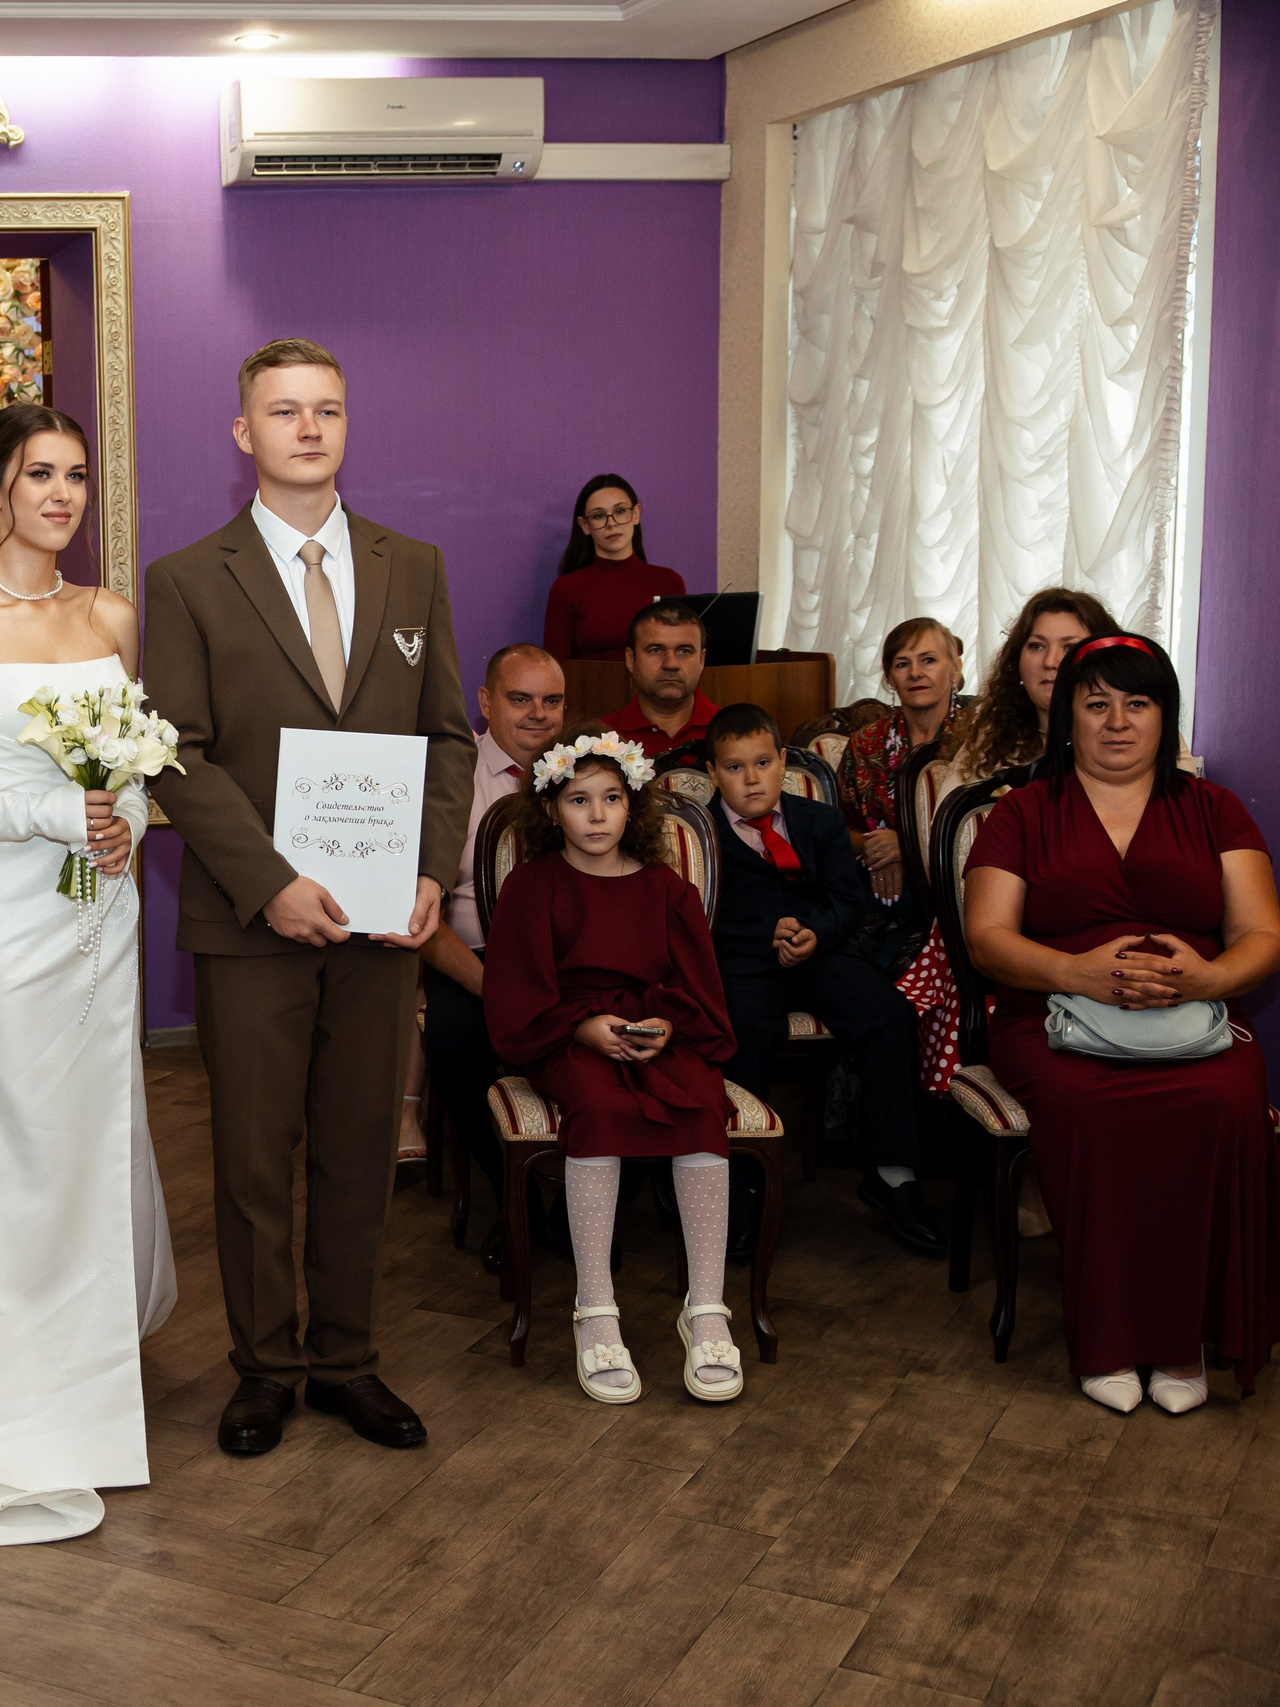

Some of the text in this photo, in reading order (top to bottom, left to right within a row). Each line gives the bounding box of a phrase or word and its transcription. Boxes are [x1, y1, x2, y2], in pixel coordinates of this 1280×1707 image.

[315, 801, 384, 812] Свидетельство
[312, 815, 366, 824] заключении
[368, 816, 394, 827] брака
